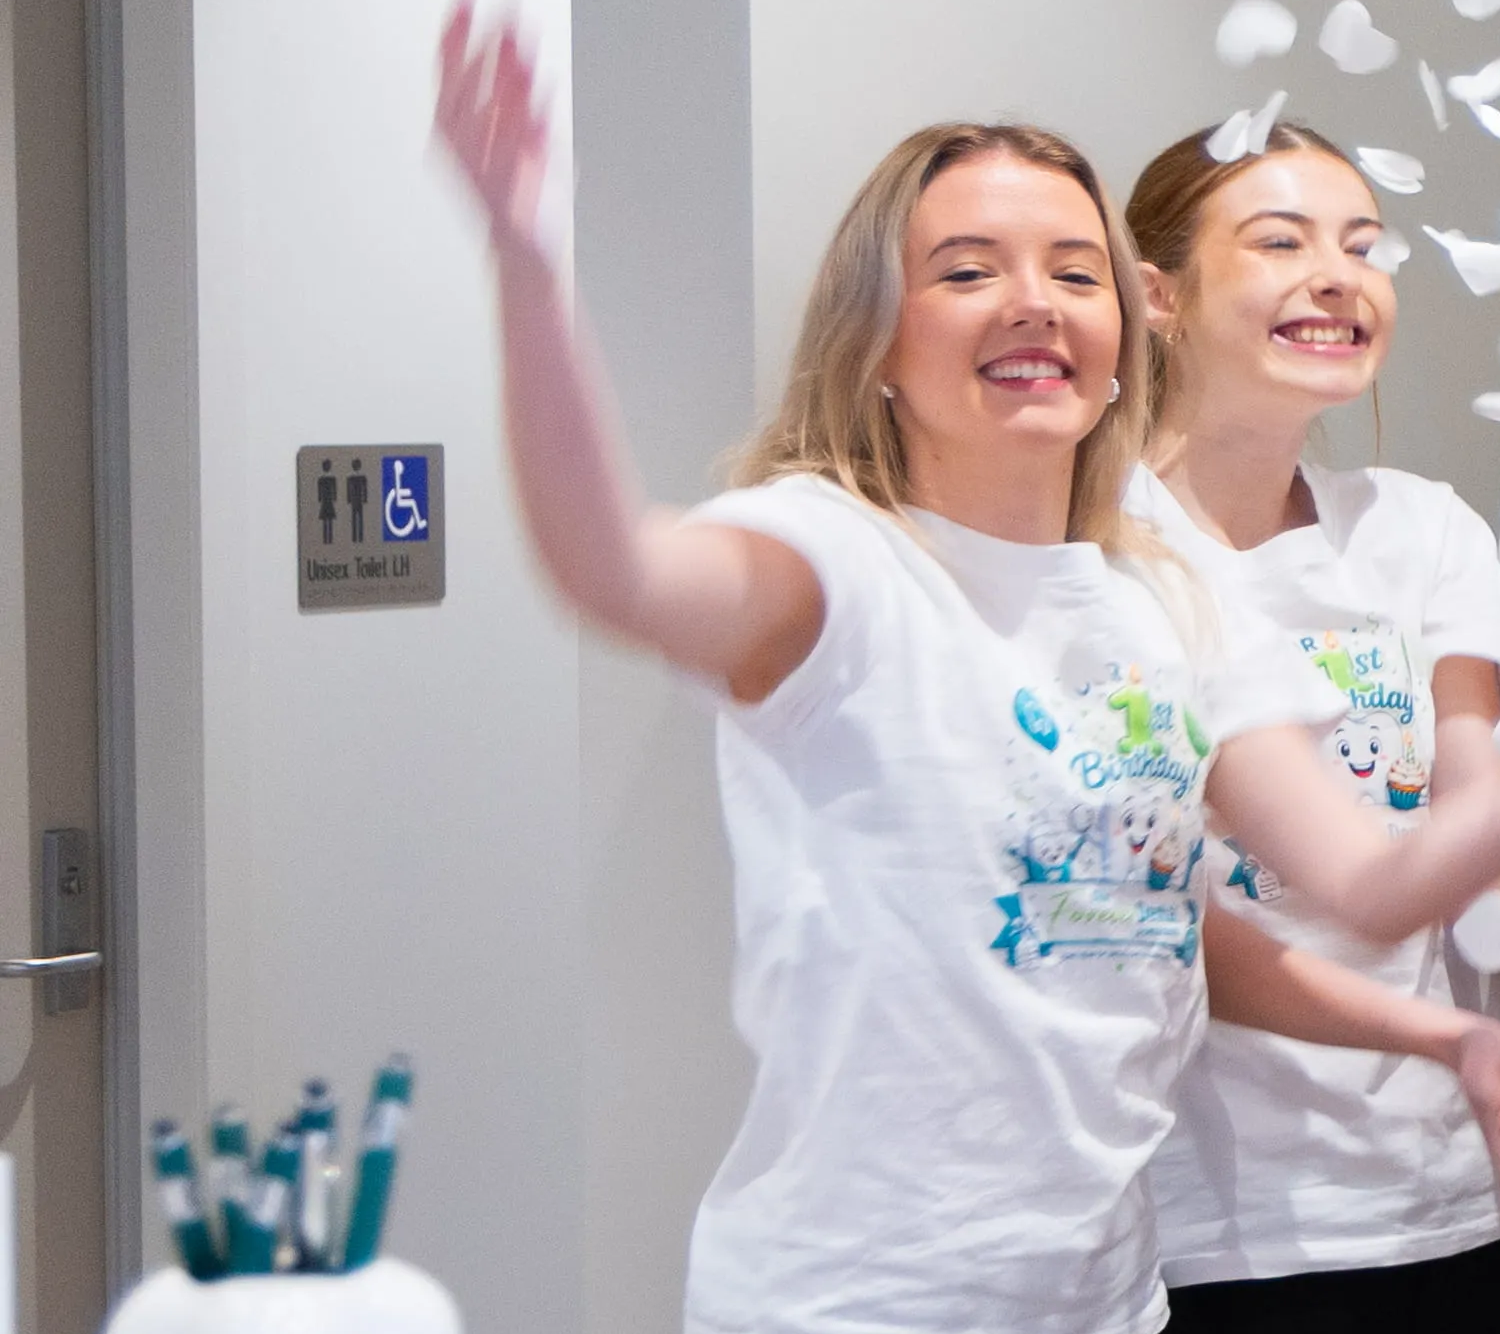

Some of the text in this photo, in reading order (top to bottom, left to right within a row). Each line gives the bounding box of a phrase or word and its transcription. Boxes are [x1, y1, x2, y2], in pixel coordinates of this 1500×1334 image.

[307, 554, 411, 582] Unisex Toilet LH
